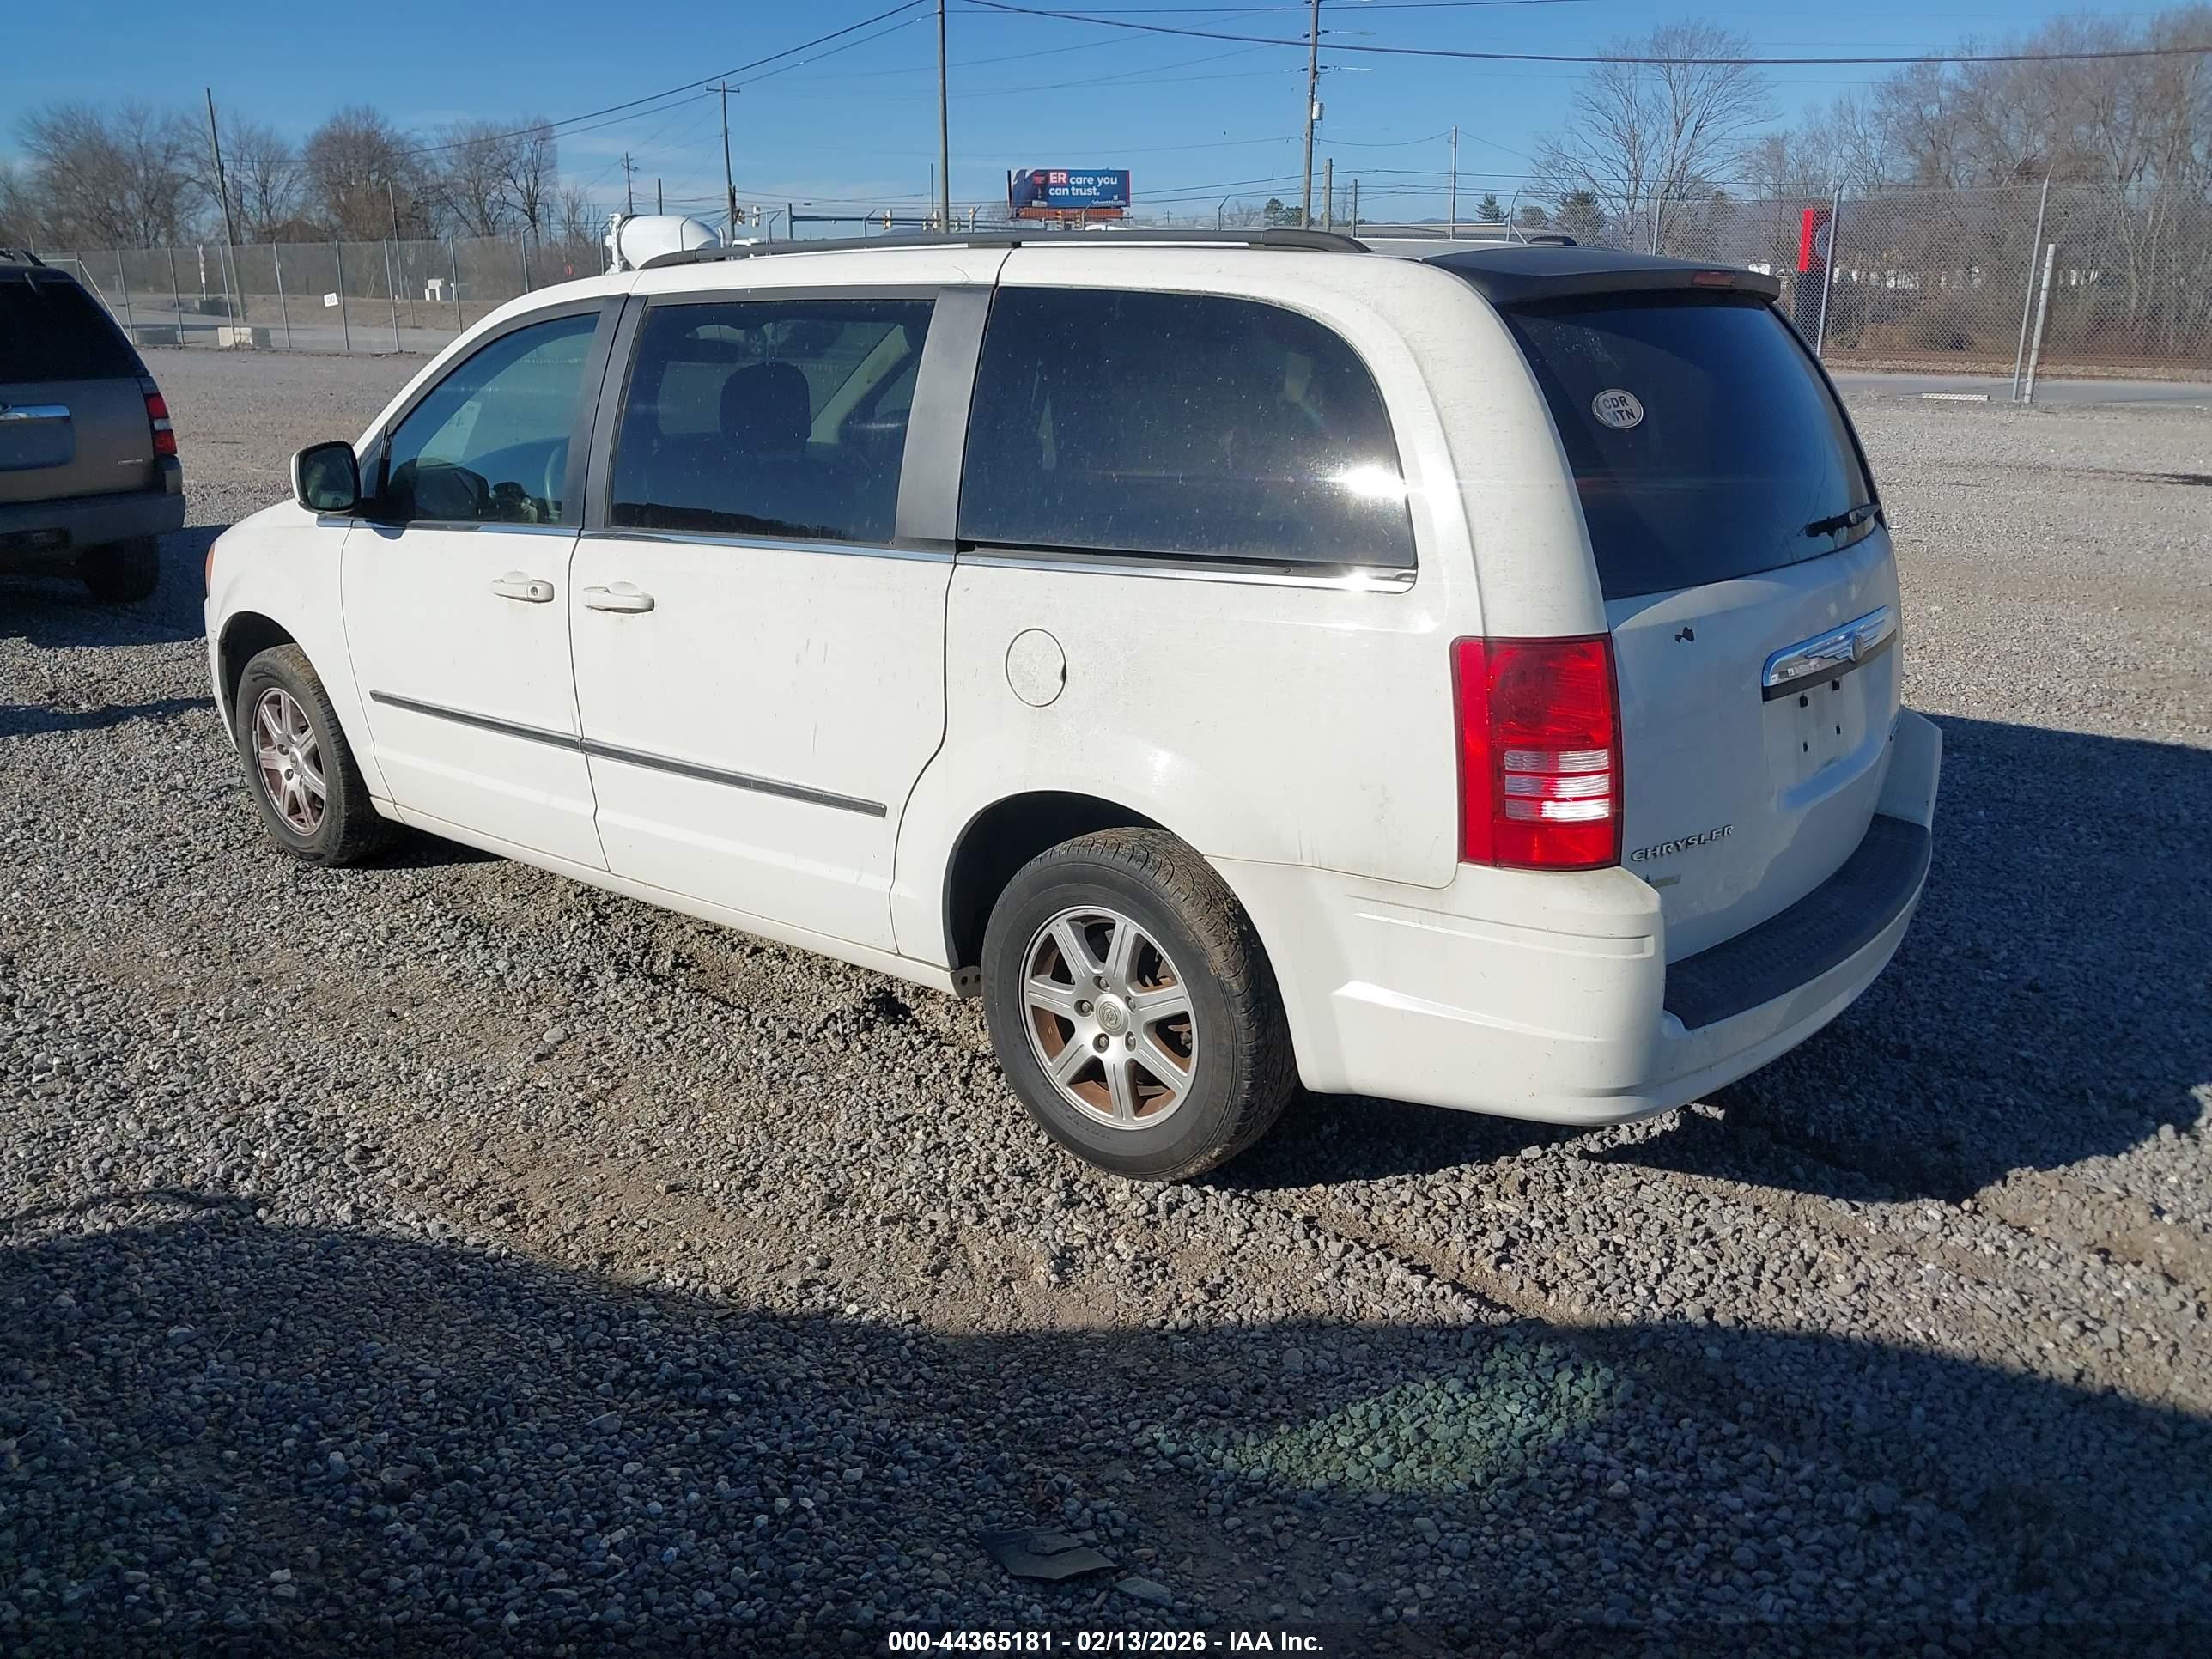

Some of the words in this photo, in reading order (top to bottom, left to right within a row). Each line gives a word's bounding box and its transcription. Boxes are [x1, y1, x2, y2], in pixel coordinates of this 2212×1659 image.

[1049, 172, 1066, 184] ER
[1069, 175, 1094, 185] care
[1097, 175, 1118, 186] you
[1048, 186, 1069, 196] can
[1071, 185, 1100, 196] trust.
[1602, 396, 1629, 409] CDR
[1631, 824, 1734, 862] CHRYSLER
